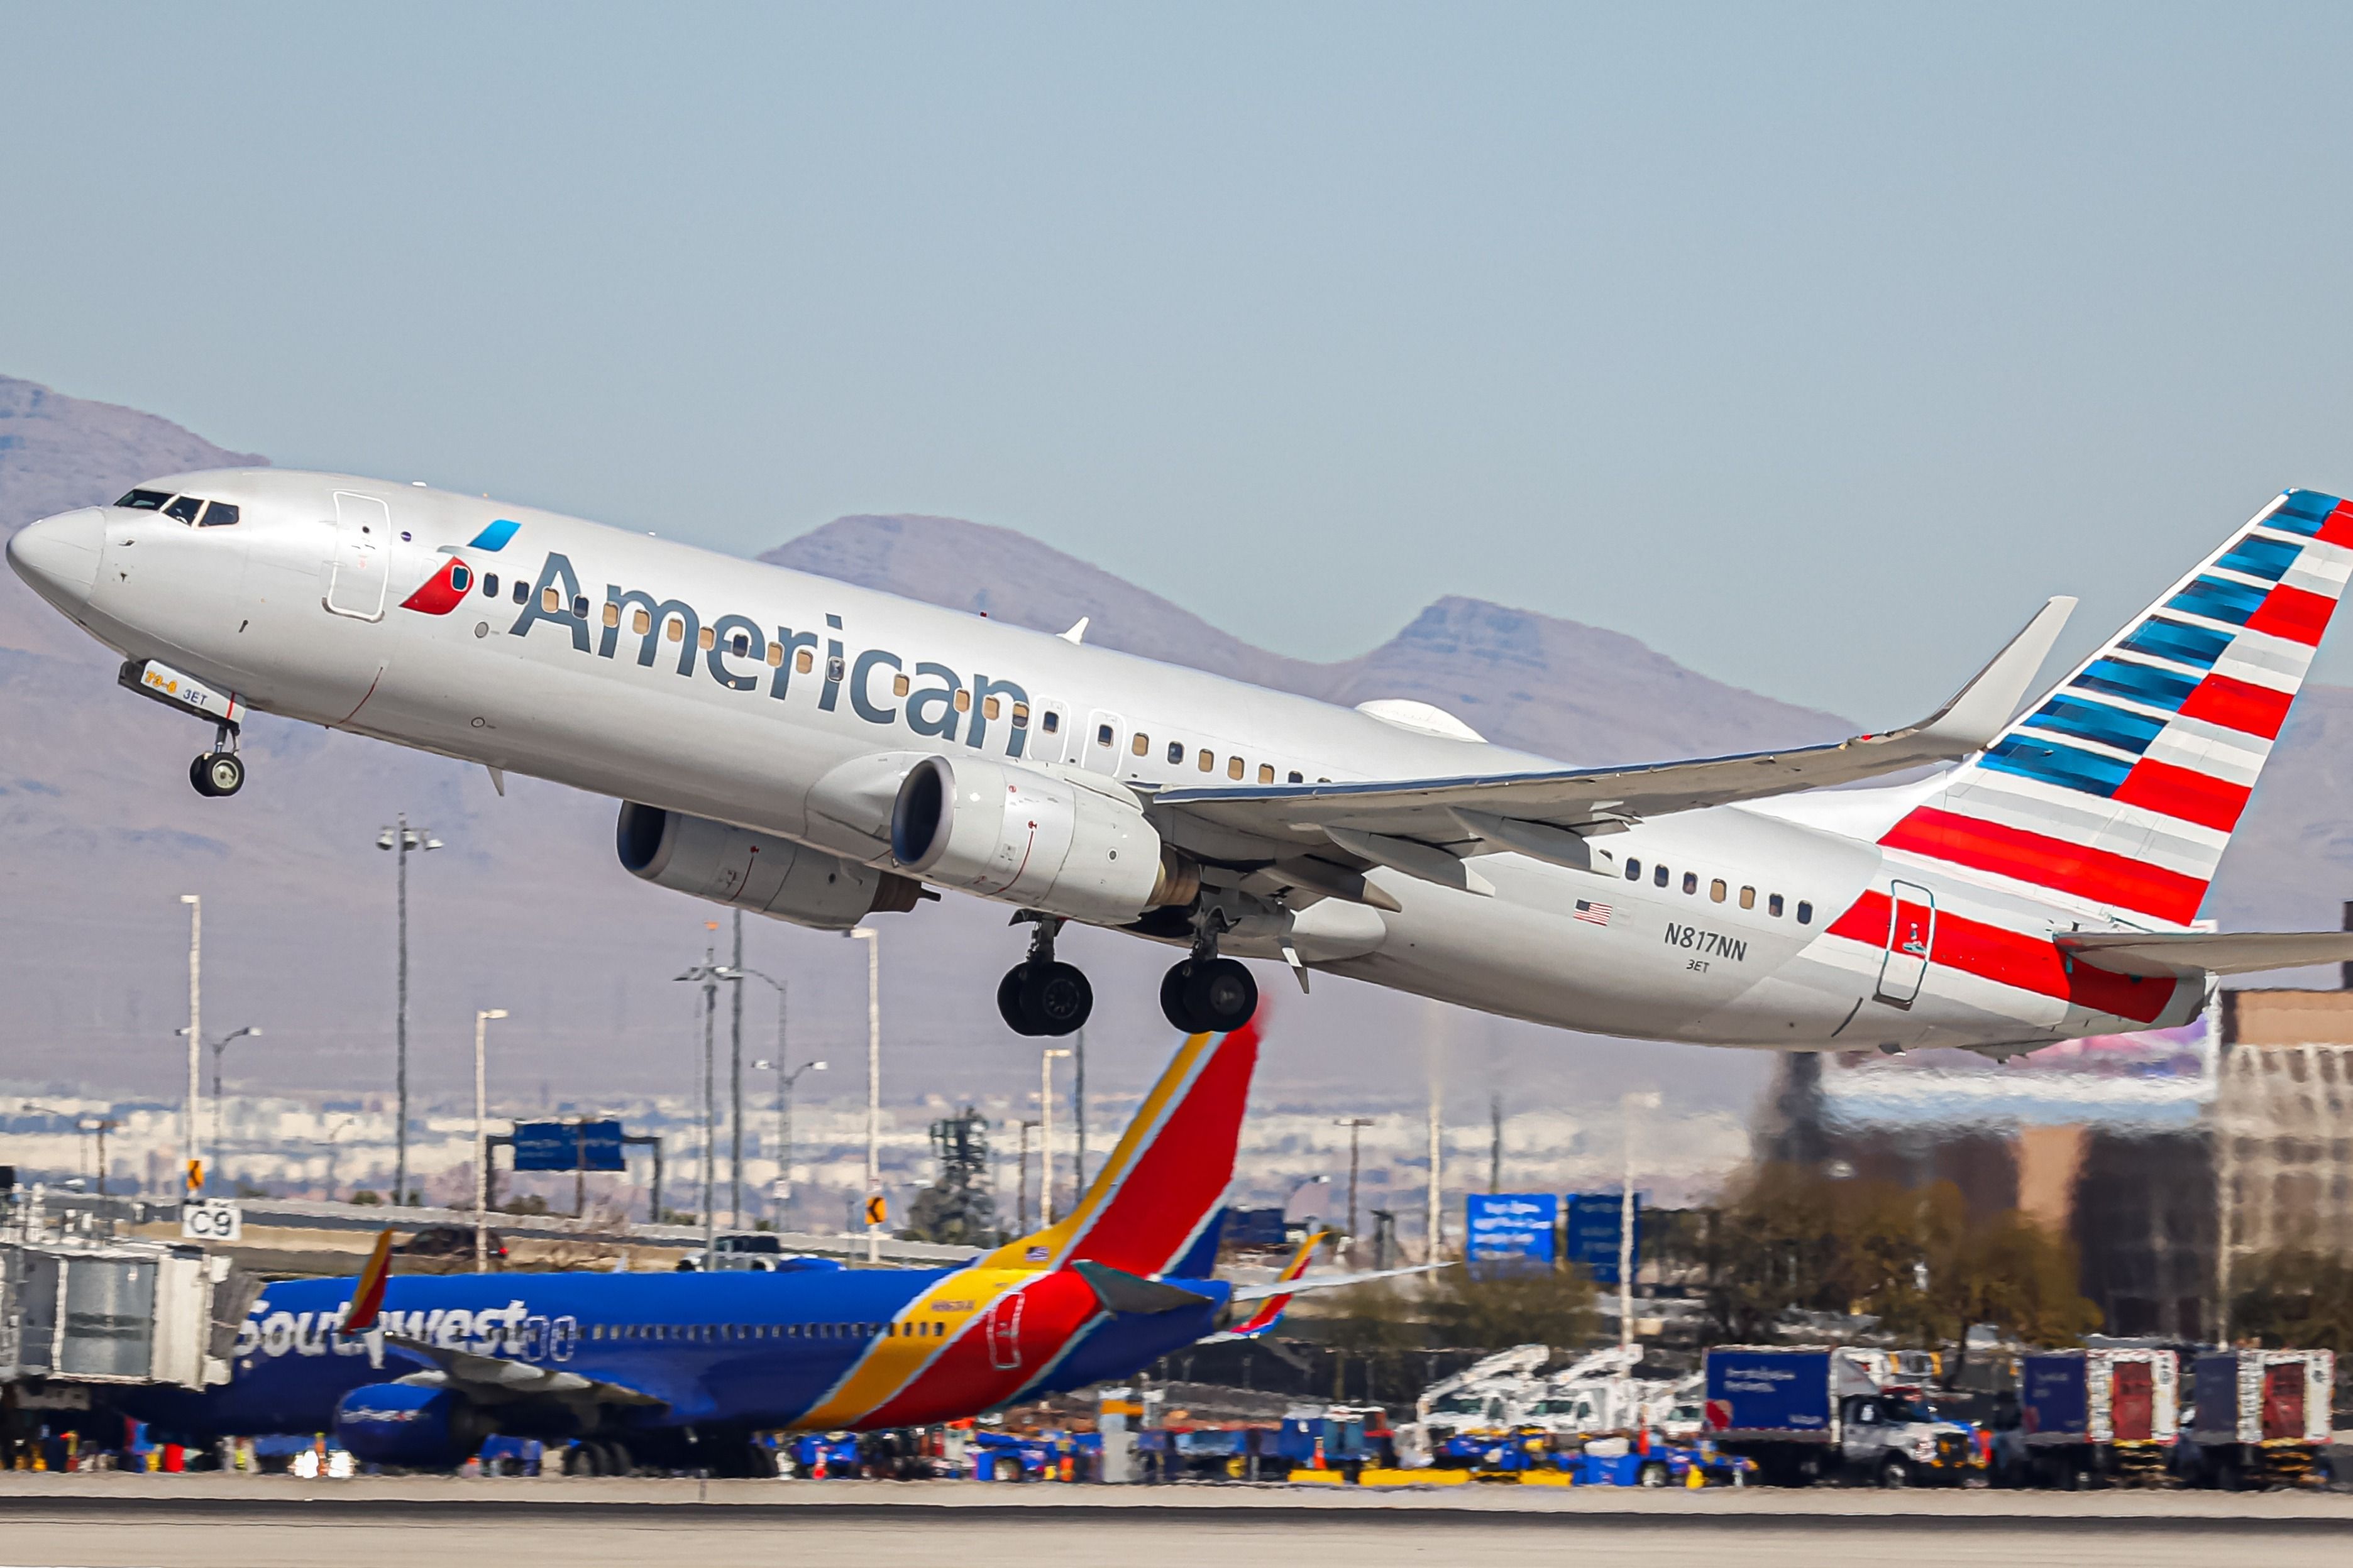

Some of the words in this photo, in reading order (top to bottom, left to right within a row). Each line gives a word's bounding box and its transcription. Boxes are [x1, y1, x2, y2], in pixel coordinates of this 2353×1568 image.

[510, 552, 1030, 758] American
[183, 689, 208, 706] 3ET
[1665, 923, 1747, 962] N817NN
[1686, 959, 1710, 973] 3ET
[190, 1210, 231, 1236] C9
